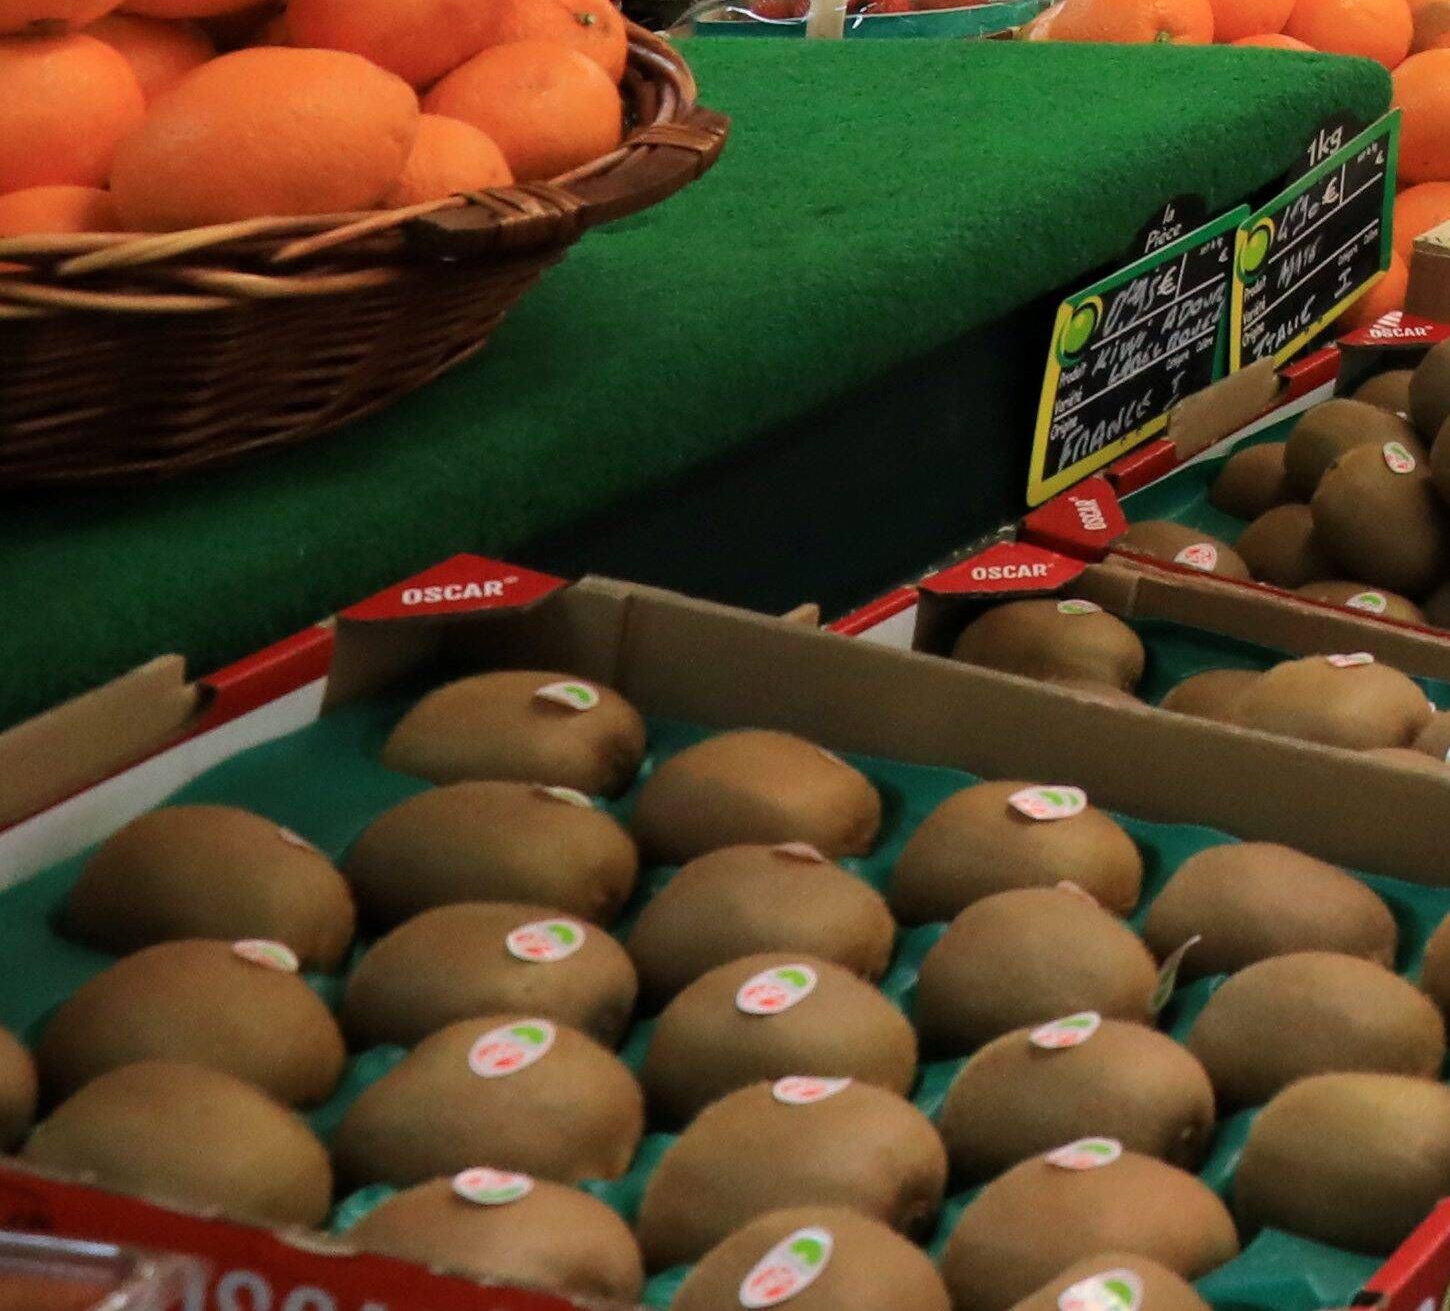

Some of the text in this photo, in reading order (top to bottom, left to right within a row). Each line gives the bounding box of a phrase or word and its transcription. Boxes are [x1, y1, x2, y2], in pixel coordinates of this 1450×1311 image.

[1306, 126, 1344, 167] 1kg
[1369, 327, 1428, 338] OSCAR
[1074, 499, 1107, 530] OSCAR
[971, 563, 1048, 581] OSCAR
[400, 578, 506, 606] OSCAR
